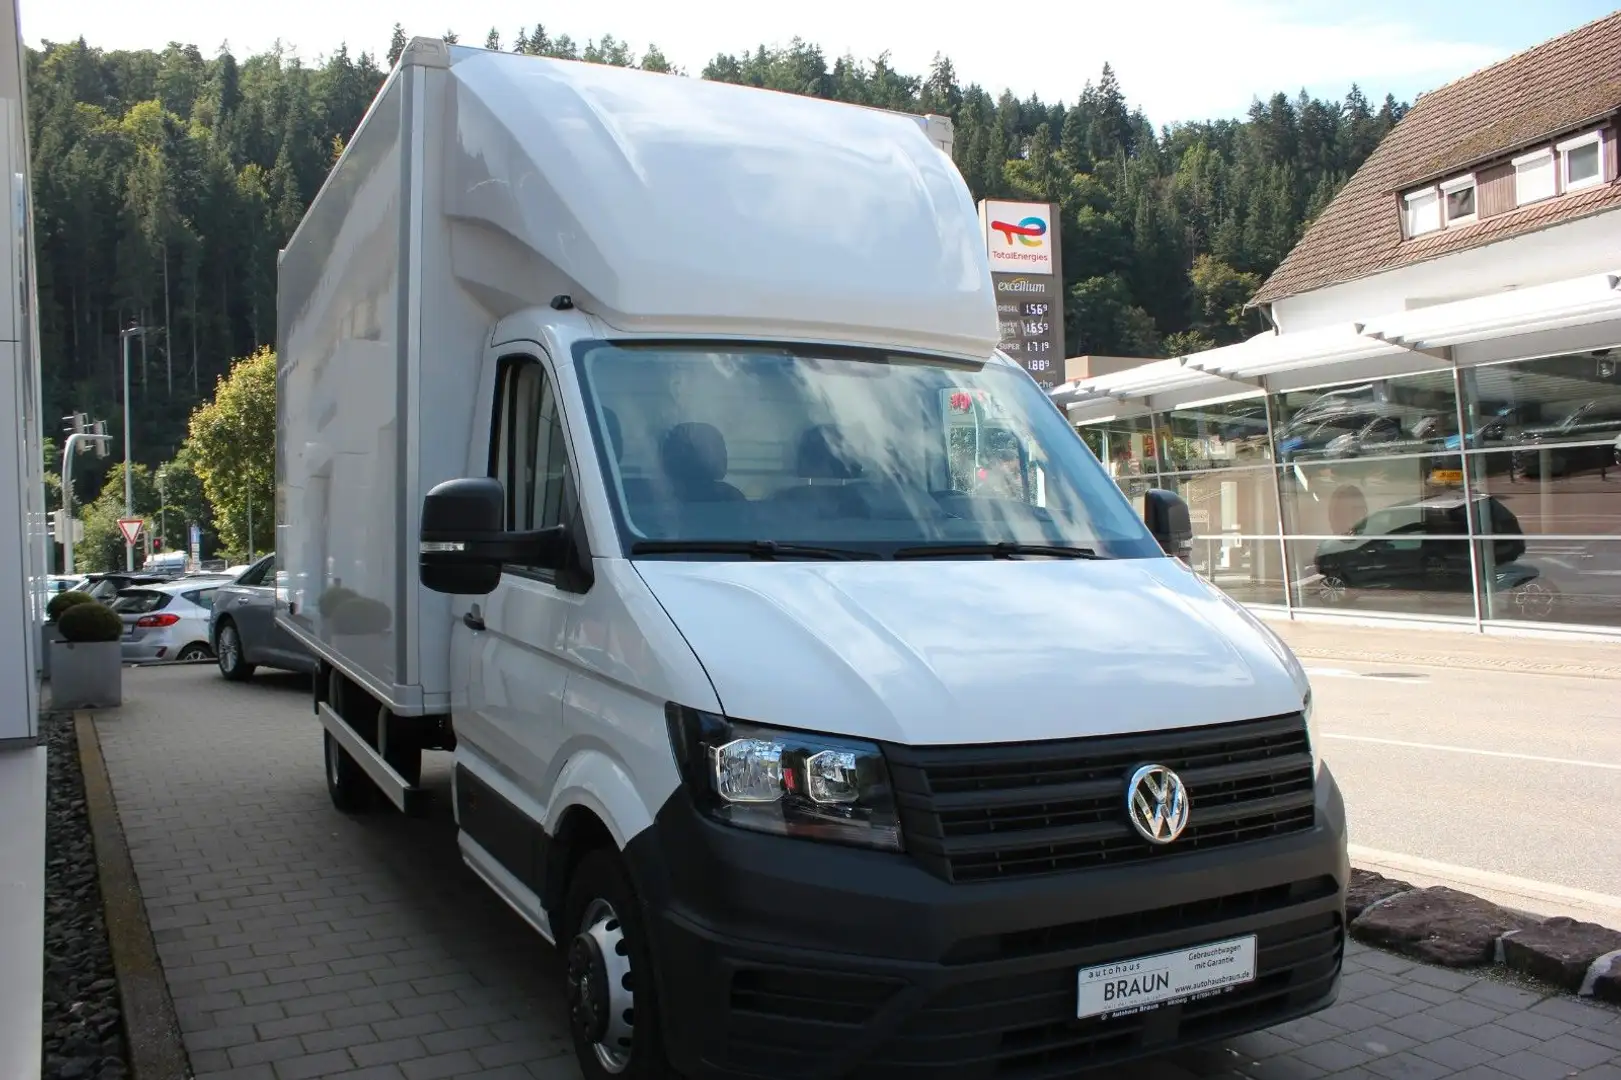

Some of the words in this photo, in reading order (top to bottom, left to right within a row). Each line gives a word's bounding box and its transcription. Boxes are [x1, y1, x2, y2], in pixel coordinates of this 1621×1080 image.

[992, 250, 1048, 262] TotalEnergies
[998, 280, 1045, 293] excellium
[999, 342, 1020, 350] SUPER
[1188, 944, 1242, 961] Gebrauchtwagen
[1088, 962, 1141, 978] autohaus
[1194, 962, 1206, 970] mit
[1207, 955, 1234, 968] Garantie
[1104, 971, 1169, 1001] BRAUN
[1174, 970, 1250, 993] www.autohausbraun.de
